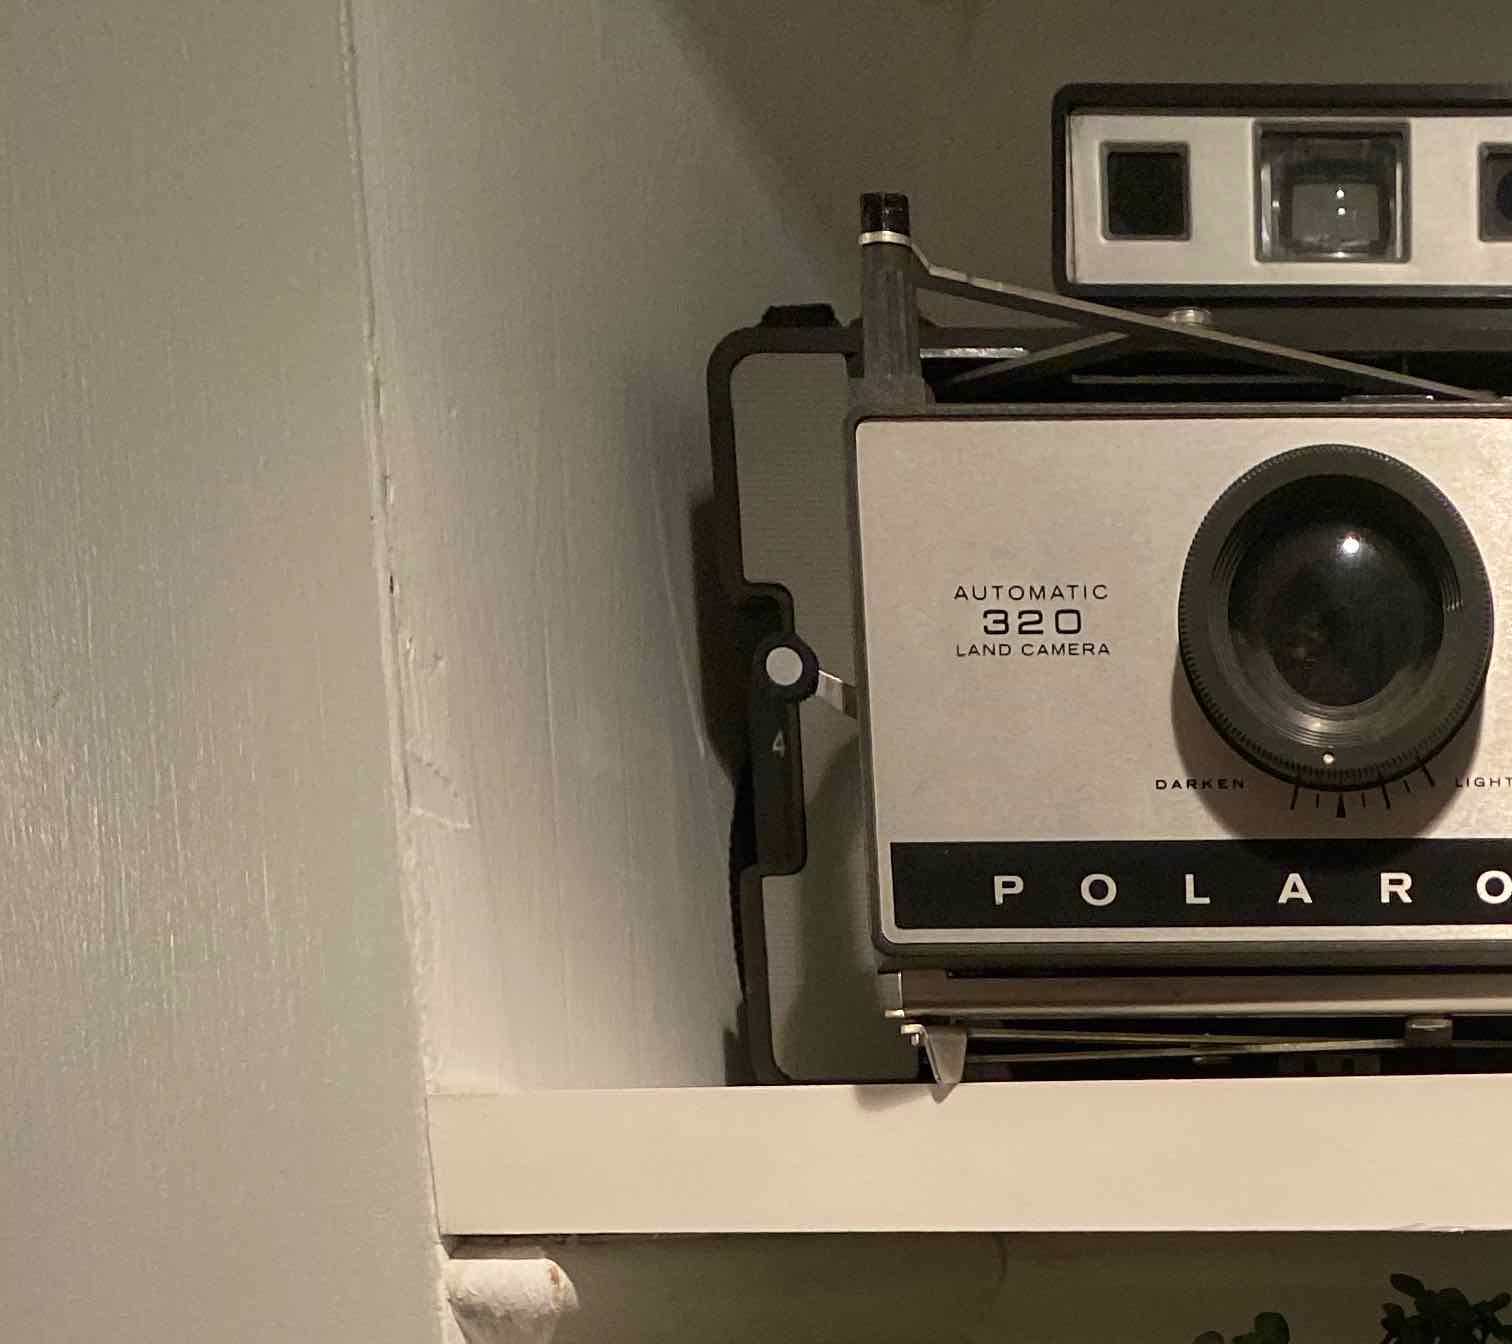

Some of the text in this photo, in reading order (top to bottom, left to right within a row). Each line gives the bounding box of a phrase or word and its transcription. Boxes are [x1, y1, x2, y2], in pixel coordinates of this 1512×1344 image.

[953, 583, 1110, 602] AUTOMATIC
[981, 608, 1083, 636] 320
[955, 641, 1111, 658] LAND CAMERA
[771, 728, 786, 758] 4
[1154, 776, 1246, 791] DARKEN
